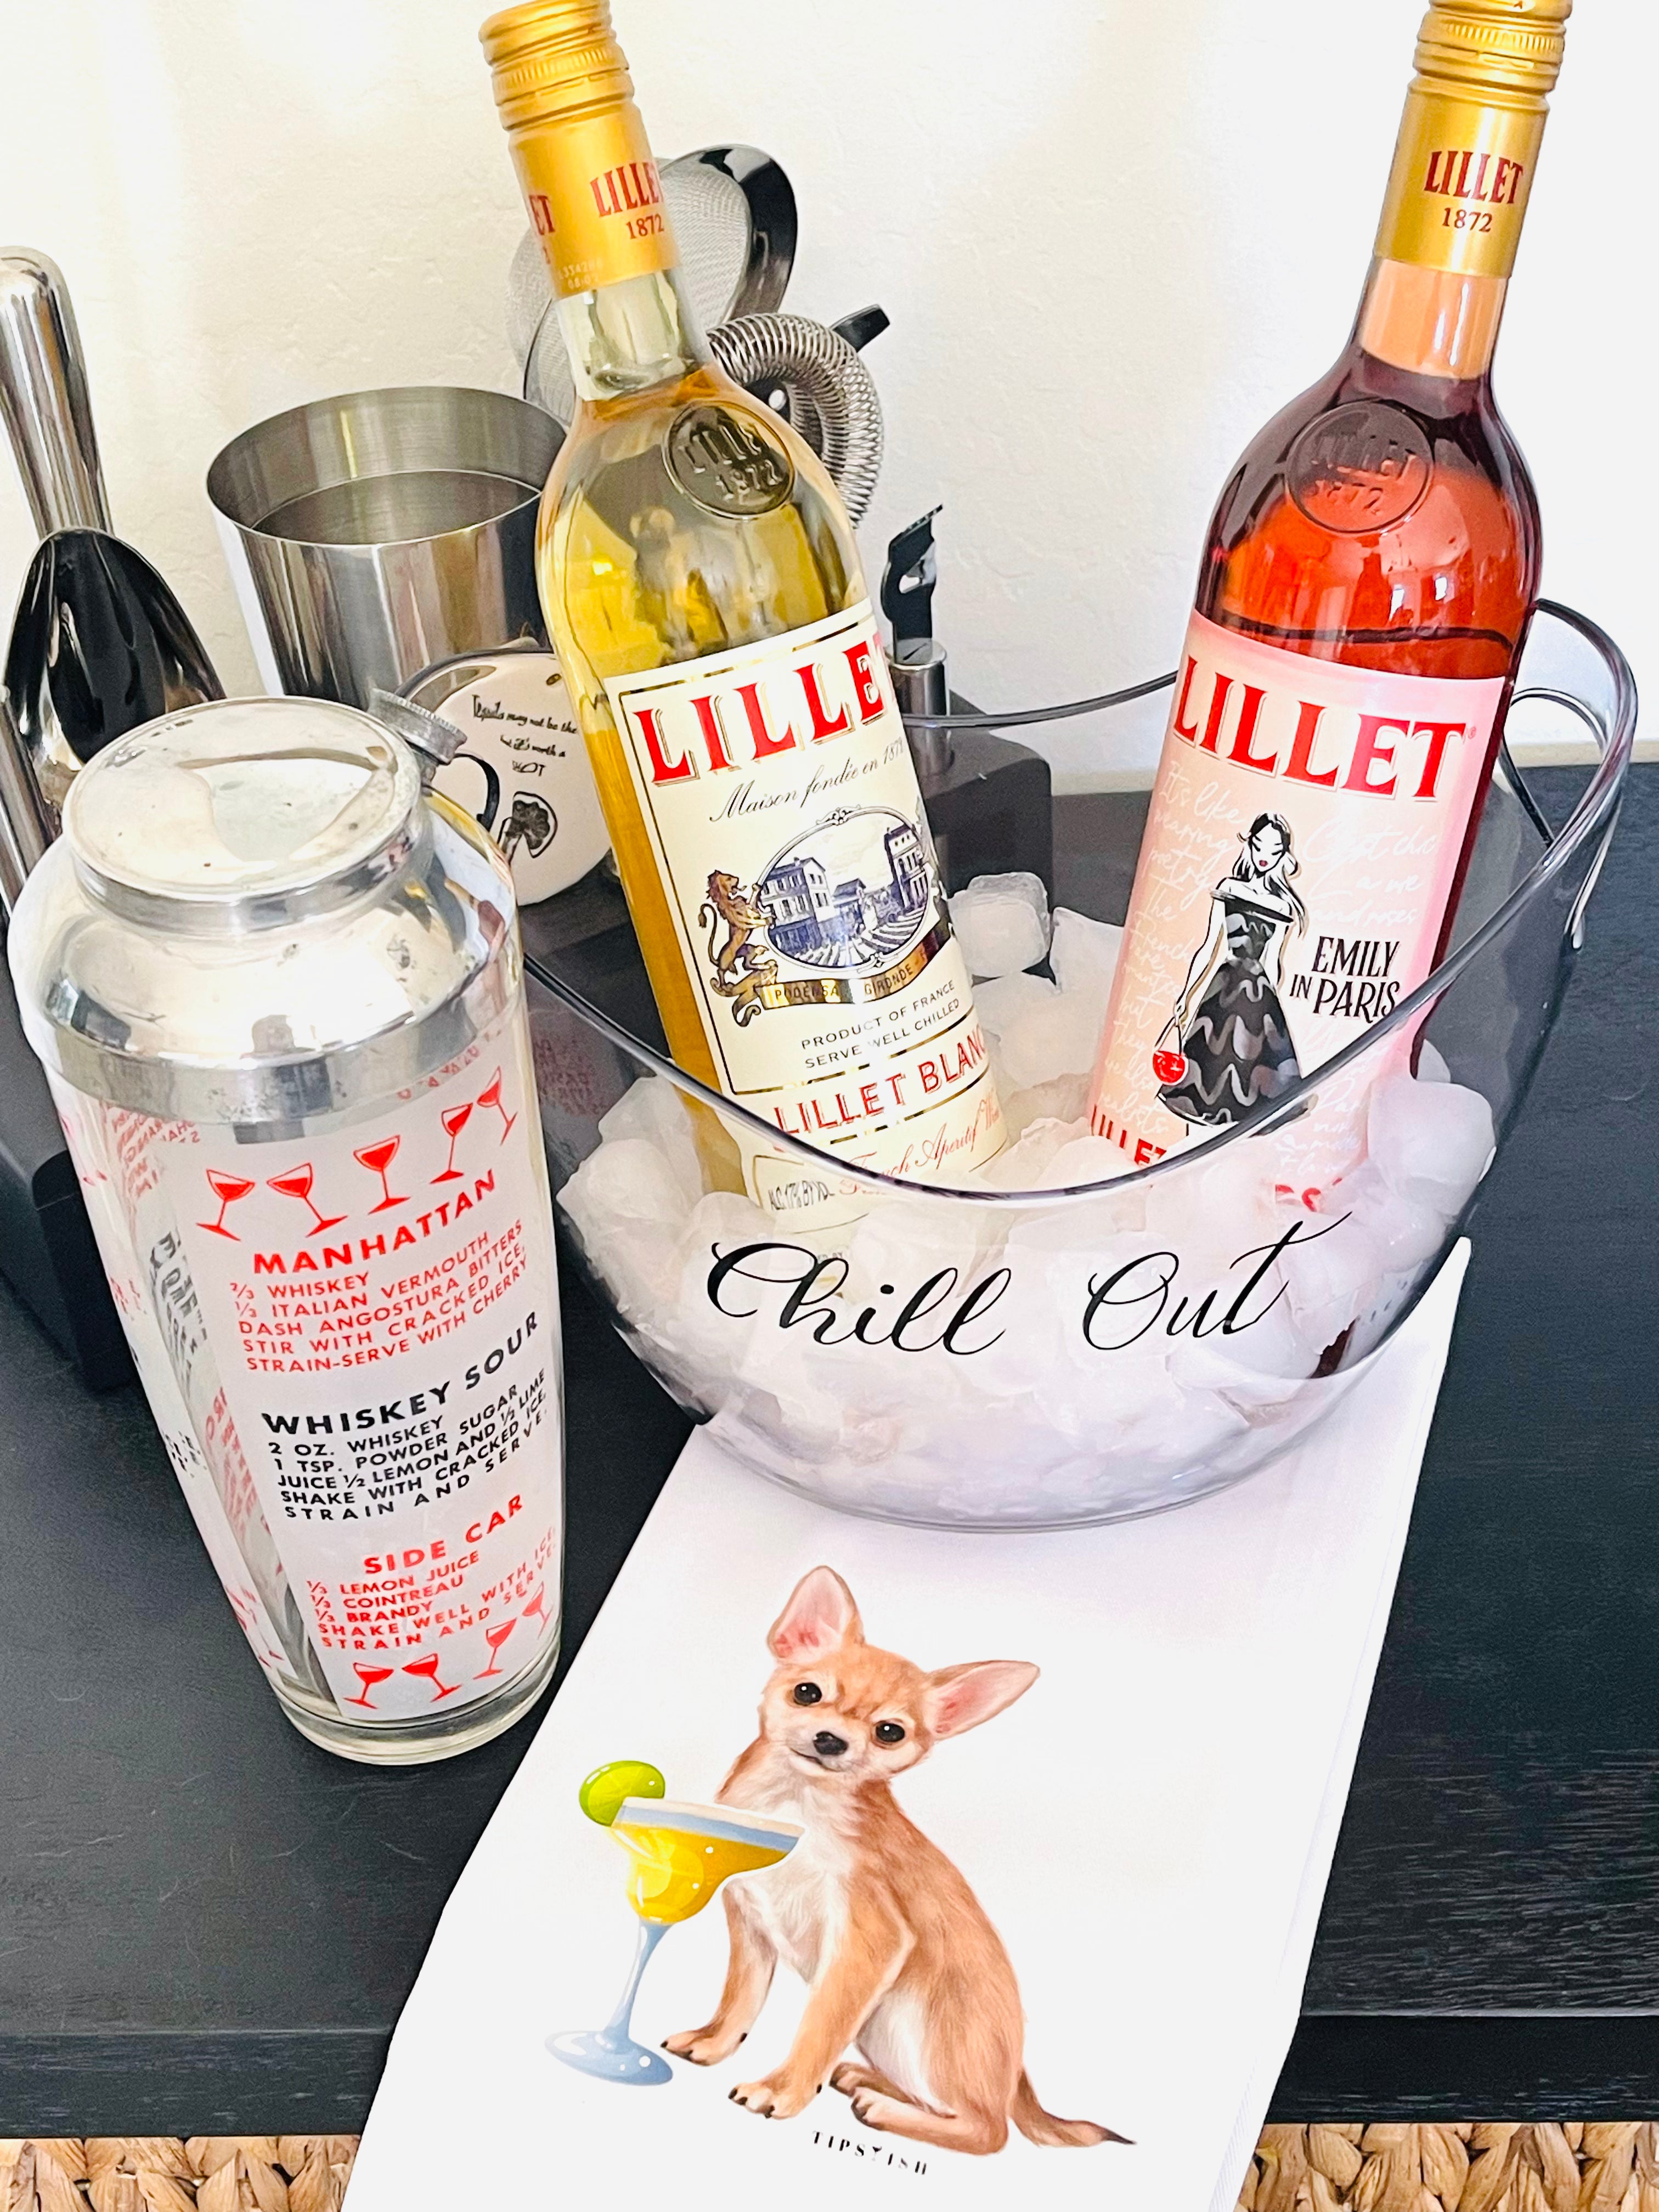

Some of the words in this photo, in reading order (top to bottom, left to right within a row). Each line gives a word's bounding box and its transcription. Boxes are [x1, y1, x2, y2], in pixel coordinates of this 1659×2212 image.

[590, 162, 662, 217] LILLE
[1424, 150, 1523, 204] LILLET
[626, 213, 664, 239] 1872
[1442, 207, 1493, 233] 1872
[632, 632, 895, 787] LILLE
[709, 780, 799, 822] Maison
[799, 757, 860, 809] fondée
[862, 759, 878, 775] en
[1312, 936, 1400, 977] EMILY
[802, 1017, 882, 1049] PRODUCT
[889, 1007, 906, 1021] OF
[913, 979, 955, 1012] FRANCE
[1289, 974, 1312, 999] IN
[1313, 978, 1400, 1024] PARIS
[805, 1045, 862, 1068] SERVE
[867, 1028, 910, 1048] WELL
[915, 998, 960, 1031] CHILLED
[774, 1073, 906, 1136] LILLET
[253, 1168, 495, 1274] MANHATTAN
[239, 1321, 303, 1336] DASH
[319, 1278, 459, 1333] ANGOSTURA
[469, 1218, 522, 1278] BITTERS
[267, 1270, 369, 1299] WHISKEY
[272, 1292, 368, 1318] ITALIAN
[381, 1231, 488, 1299] VERMOUTH
[707, 1241, 1012, 1356] Chill
[1081, 1210, 1354, 1351] Out
[243, 1339, 295, 1355] STIR
[309, 1330, 373, 1353] WITH
[387, 1275, 489, 1336] CRACKED
[247, 1339, 410, 1373] STRAIN-SERVE
[417, 1311, 466, 1345] WITH
[472, 1254, 527, 1314] CHERRY
[261, 1380, 450, 1436] WHISKEY
[466, 1311, 538, 1390] SOUR
[268, 1442, 282, 1455] 2
[295, 1443, 335, 1457] OZ.
[347, 1414, 444, 1453] WHISKEY
[274, 1458, 283, 1471] 1
[300, 1460, 343, 1473] TSP.
[357, 1432, 448, 1469] POWDER
[460, 1384, 517, 1435] SUGAR
[278, 1475, 336, 1490] JUICE
[373, 1449, 449, 1483] LEMON
[456, 1422, 495, 1455] AND
[520, 1368, 544, 1409] LIME
[281, 1491, 356, 1505] SHAKE
[368, 1477, 422, 1500] WITH
[436, 1421, 519, 1481] CRACKED
[285, 1501, 394, 1520] STRAIN
[414, 1474, 471, 1508] AND
[363, 1540, 448, 1575] SIDE
[466, 1494, 522, 1543] CAR
[318, 1622, 399, 1637] SHAKE
[413, 1603, 469, 1629] WELL
[481, 1561, 526, 1603] WITH
[340, 1575, 414, 1595] LEMON
[426, 1550, 479, 1582] JUICE
[343, 1575, 464, 1609] COINTREAU
[321, 1634, 422, 1650] STRAIN
[439, 1607, 490, 1638] AND
[347, 1601, 433, 1623] BRANDY
